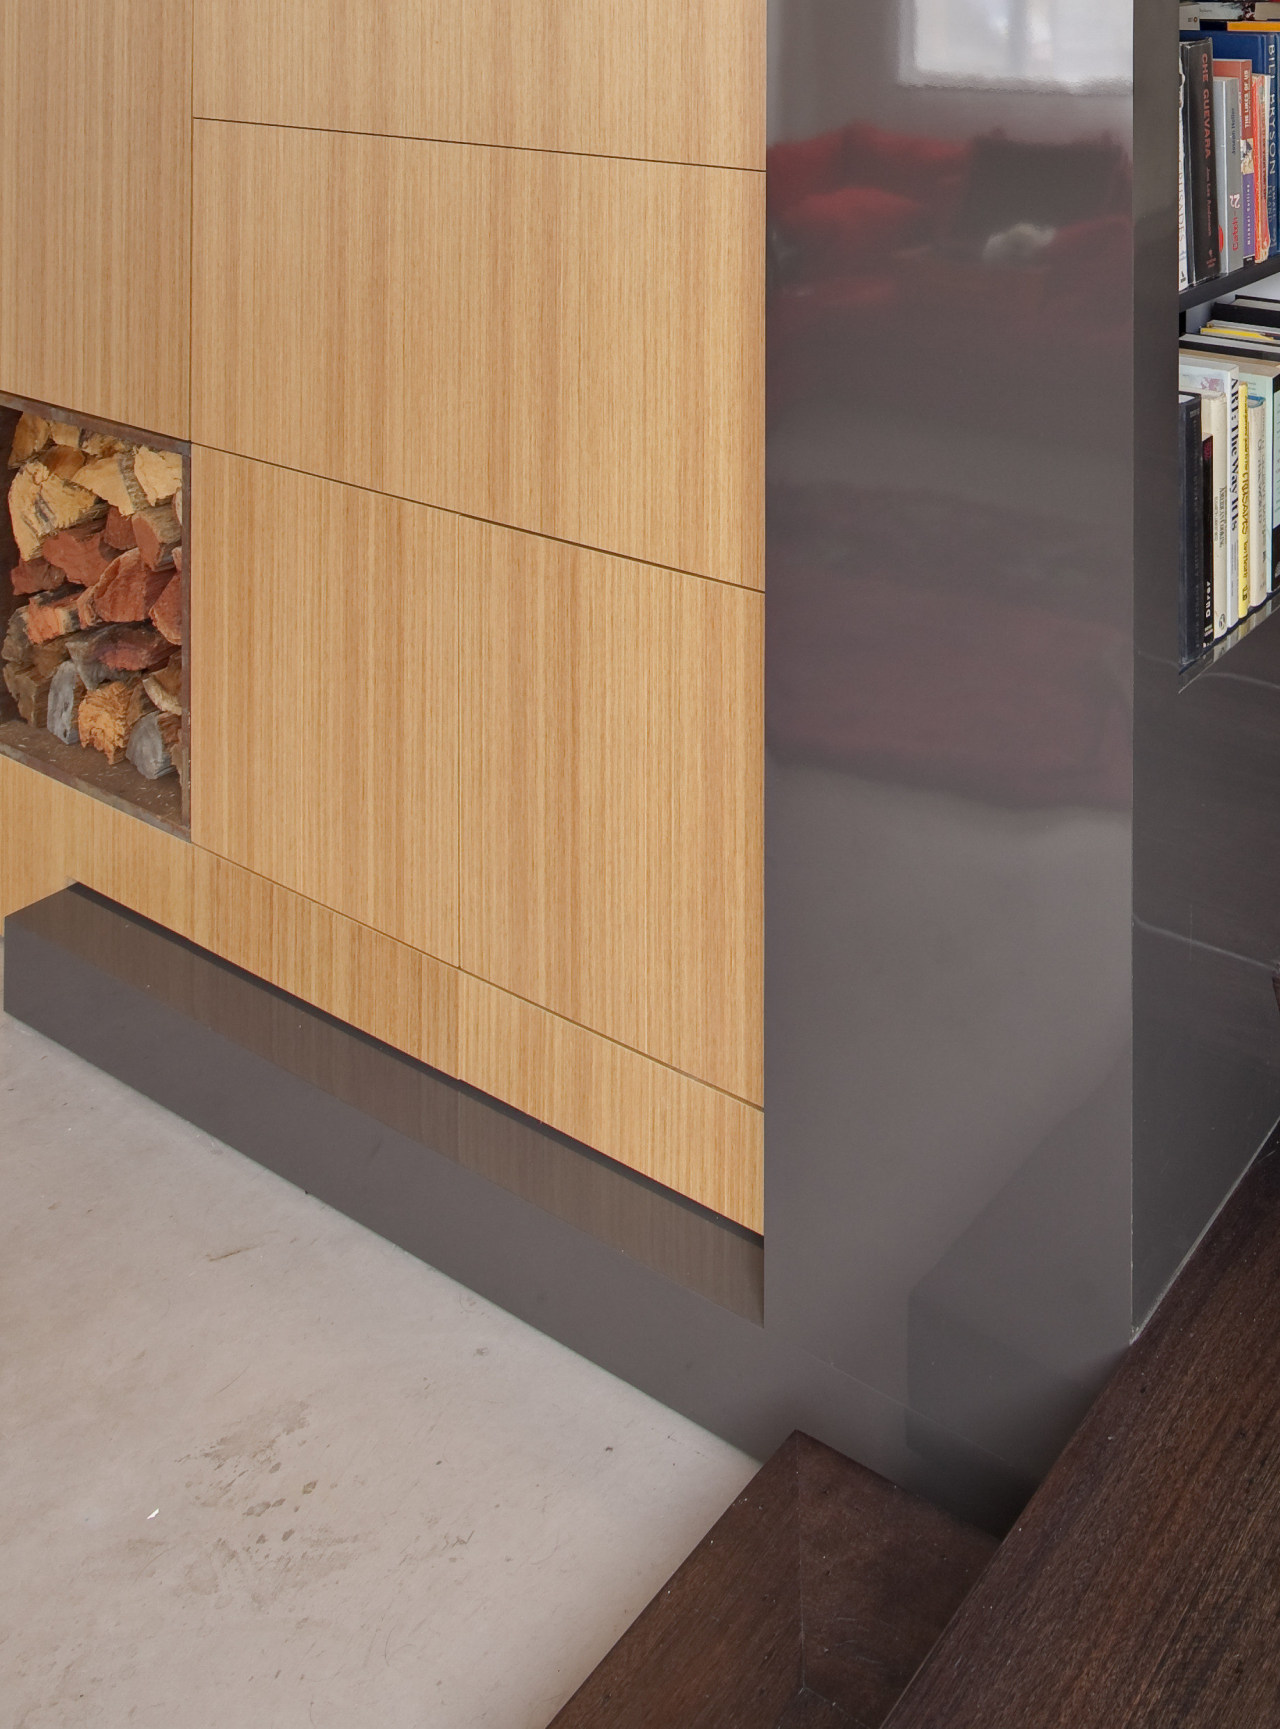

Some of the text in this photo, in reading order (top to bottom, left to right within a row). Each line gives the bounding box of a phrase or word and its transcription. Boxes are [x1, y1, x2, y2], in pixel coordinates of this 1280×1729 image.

[1200, 52, 1211, 159] CHE GUEVARA
[1228, 375, 1239, 532] ART: The Way It Is
